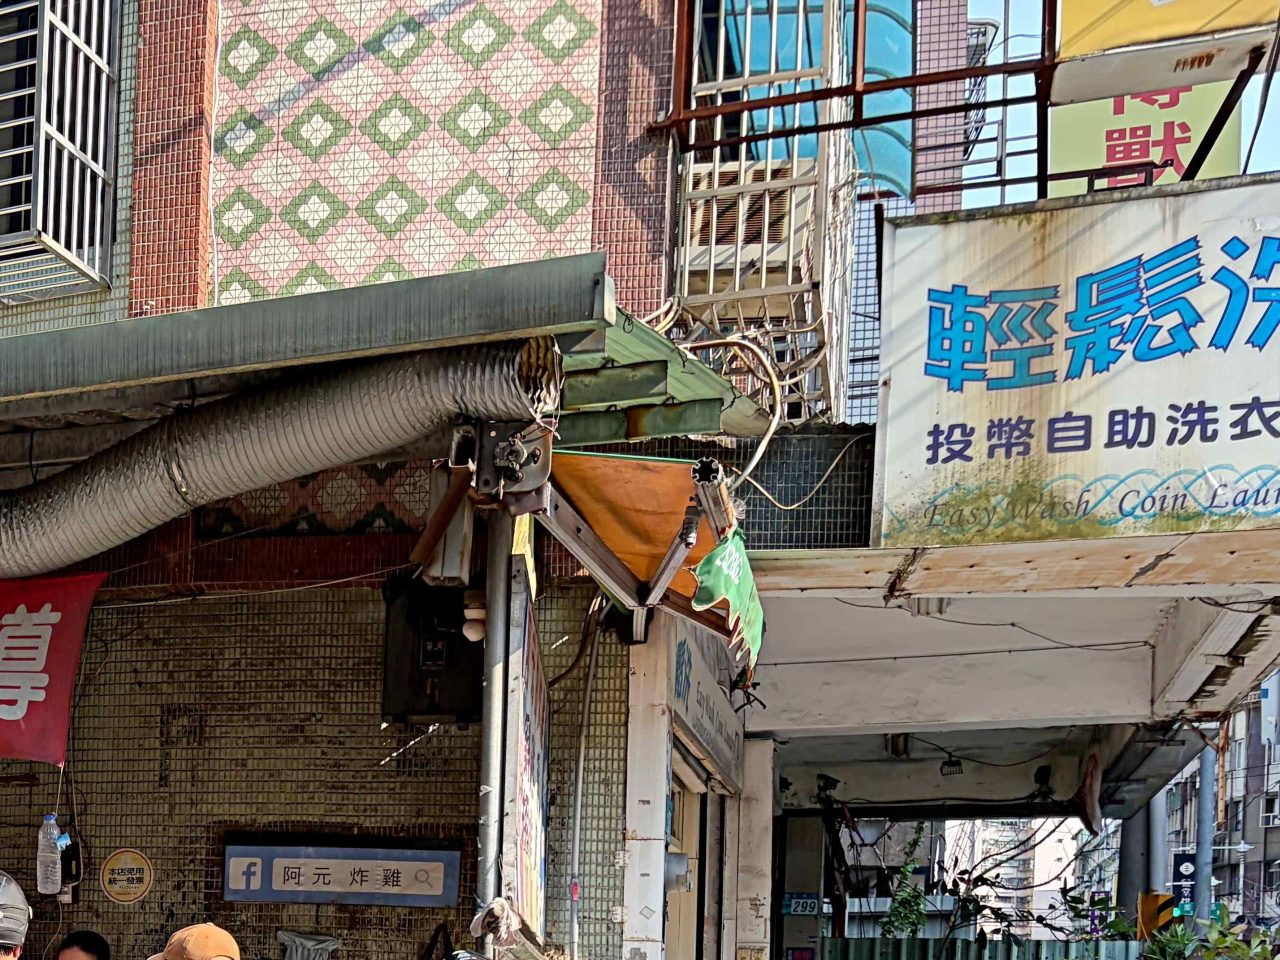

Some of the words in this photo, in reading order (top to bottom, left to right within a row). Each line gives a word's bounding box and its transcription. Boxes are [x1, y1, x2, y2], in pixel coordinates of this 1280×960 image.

[926, 396, 1280, 465] 投幣自助洗衣
[924, 502, 997, 532] Easy
[1005, 489, 1091, 520] Wash
[1118, 488, 1188, 518] Coin
[283, 866, 402, 888] 阿元炸雞
[793, 900, 816, 913] 299
